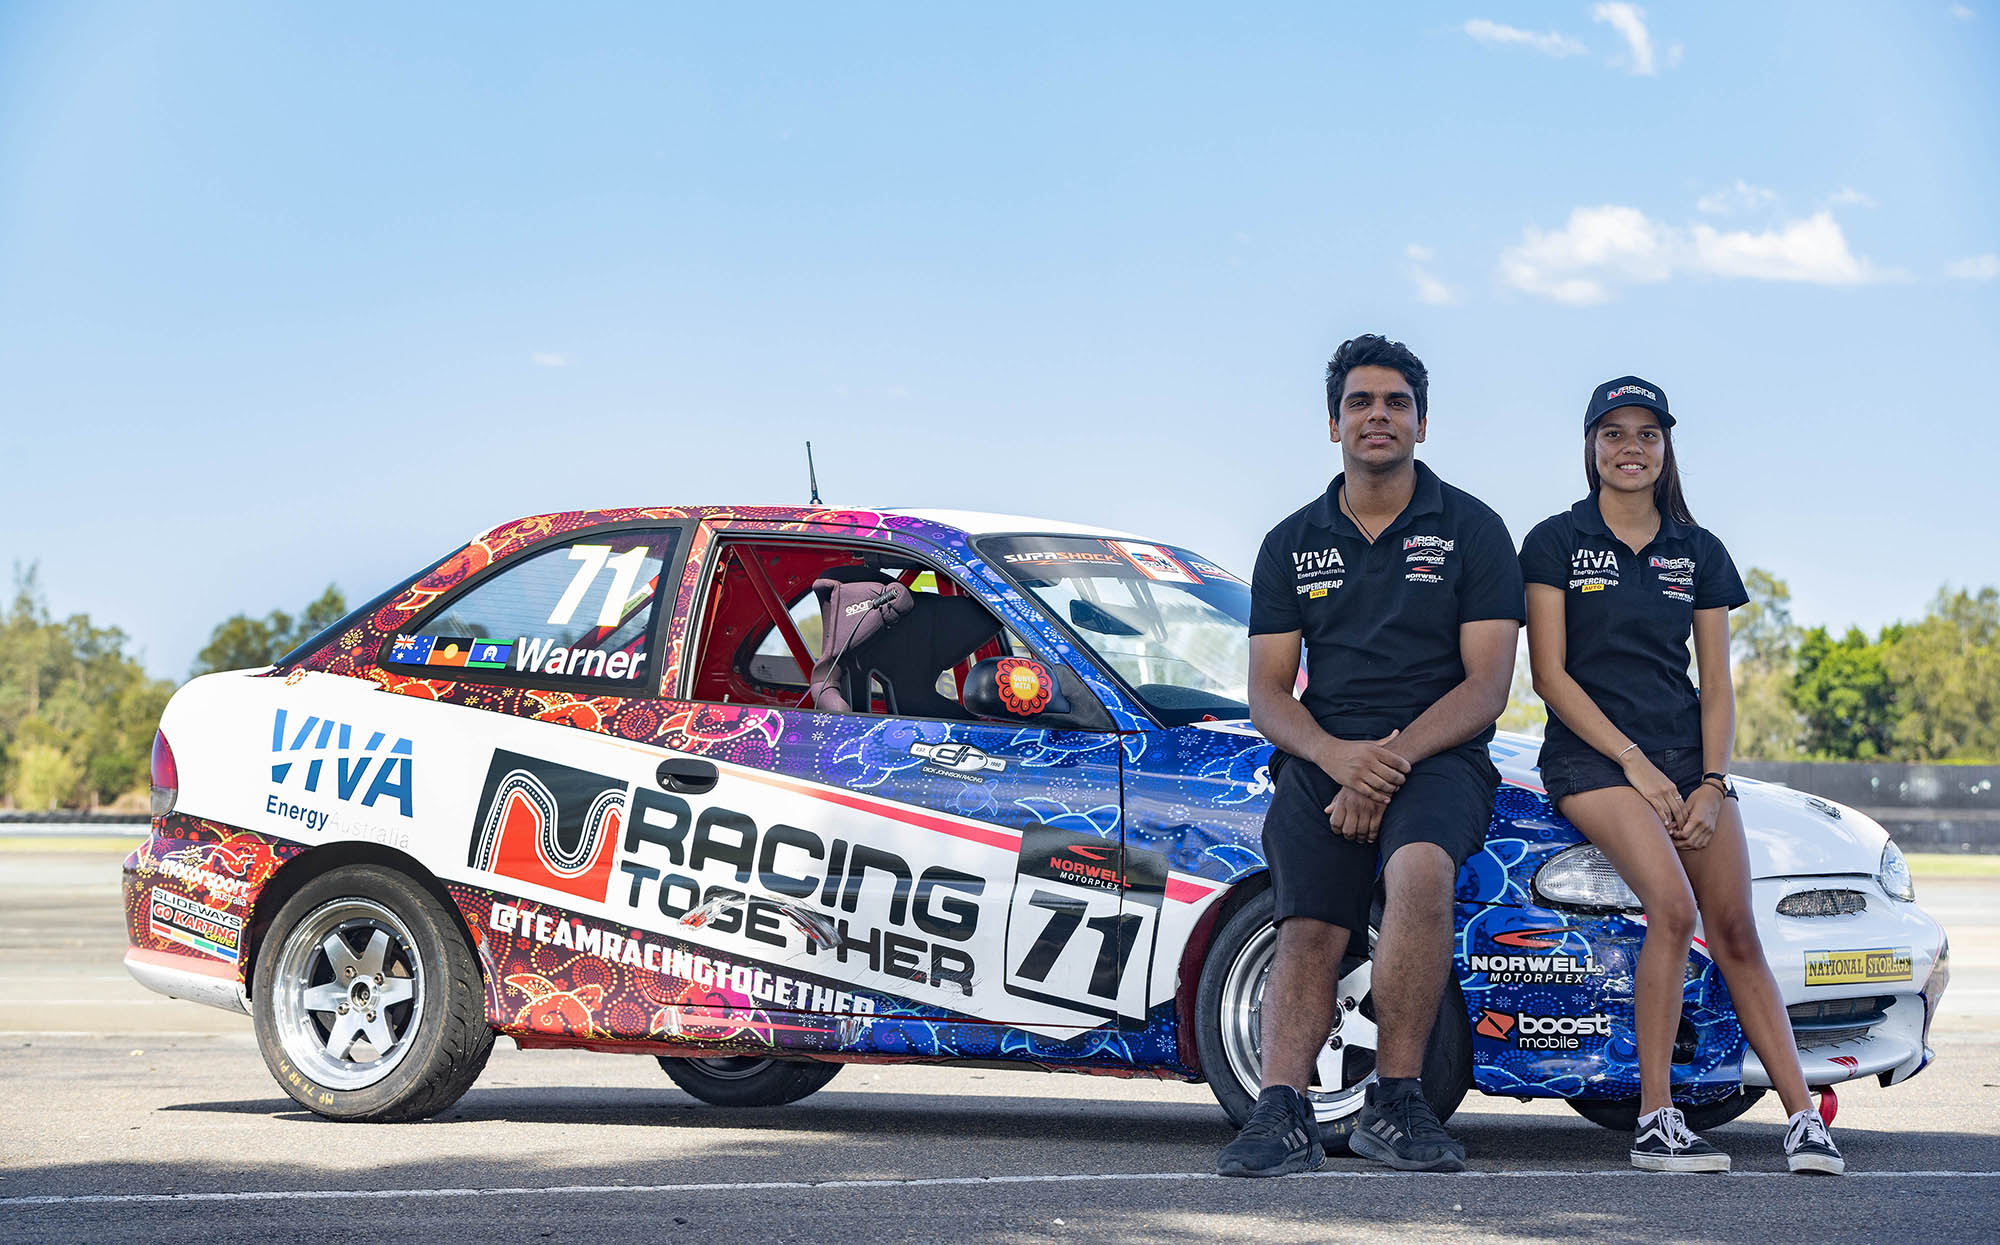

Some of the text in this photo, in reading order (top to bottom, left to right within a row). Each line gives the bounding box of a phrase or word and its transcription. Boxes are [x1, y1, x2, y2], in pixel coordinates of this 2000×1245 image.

[1417, 535, 1454, 548] RACING
[1003, 551, 1118, 563] SUPASHOCK
[1291, 548, 1345, 571] VIVA
[1571, 549, 1619, 571] VIVA
[547, 544, 650, 627] 71
[1296, 580, 1344, 595] SUPERCHEAP
[1569, 577, 1619, 589] SUPERCHEAP
[515, 637, 647, 680] Warner
[271, 708, 414, 818] VIVA
[922, 766, 984, 784] DICK JOHNSON RACING
[623, 786, 986, 941] RACING
[1050, 857, 1132, 888] NORWELL
[158, 859, 251, 898] motorsport
[1060, 871, 1120, 892] MOTORPLEX
[153, 889, 241, 928] SLIDEWAYS
[154, 904, 237, 942] GO KARTING
[620, 860, 976, 997] TOGETHER
[204, 931, 236, 948] Centres
[1015, 888, 1144, 1001] 71
[490, 902, 875, 1029] @TEAMRACINGTOGETHER
[1471, 956, 1599, 972] NORWELL
[1808, 955, 1911, 977] NATIONAL STORAGE
[1490, 973, 1583, 983] MOTORPLEX
[1518, 1013, 1609, 1035] boost
[1519, 1036, 1579, 1049] mobile
